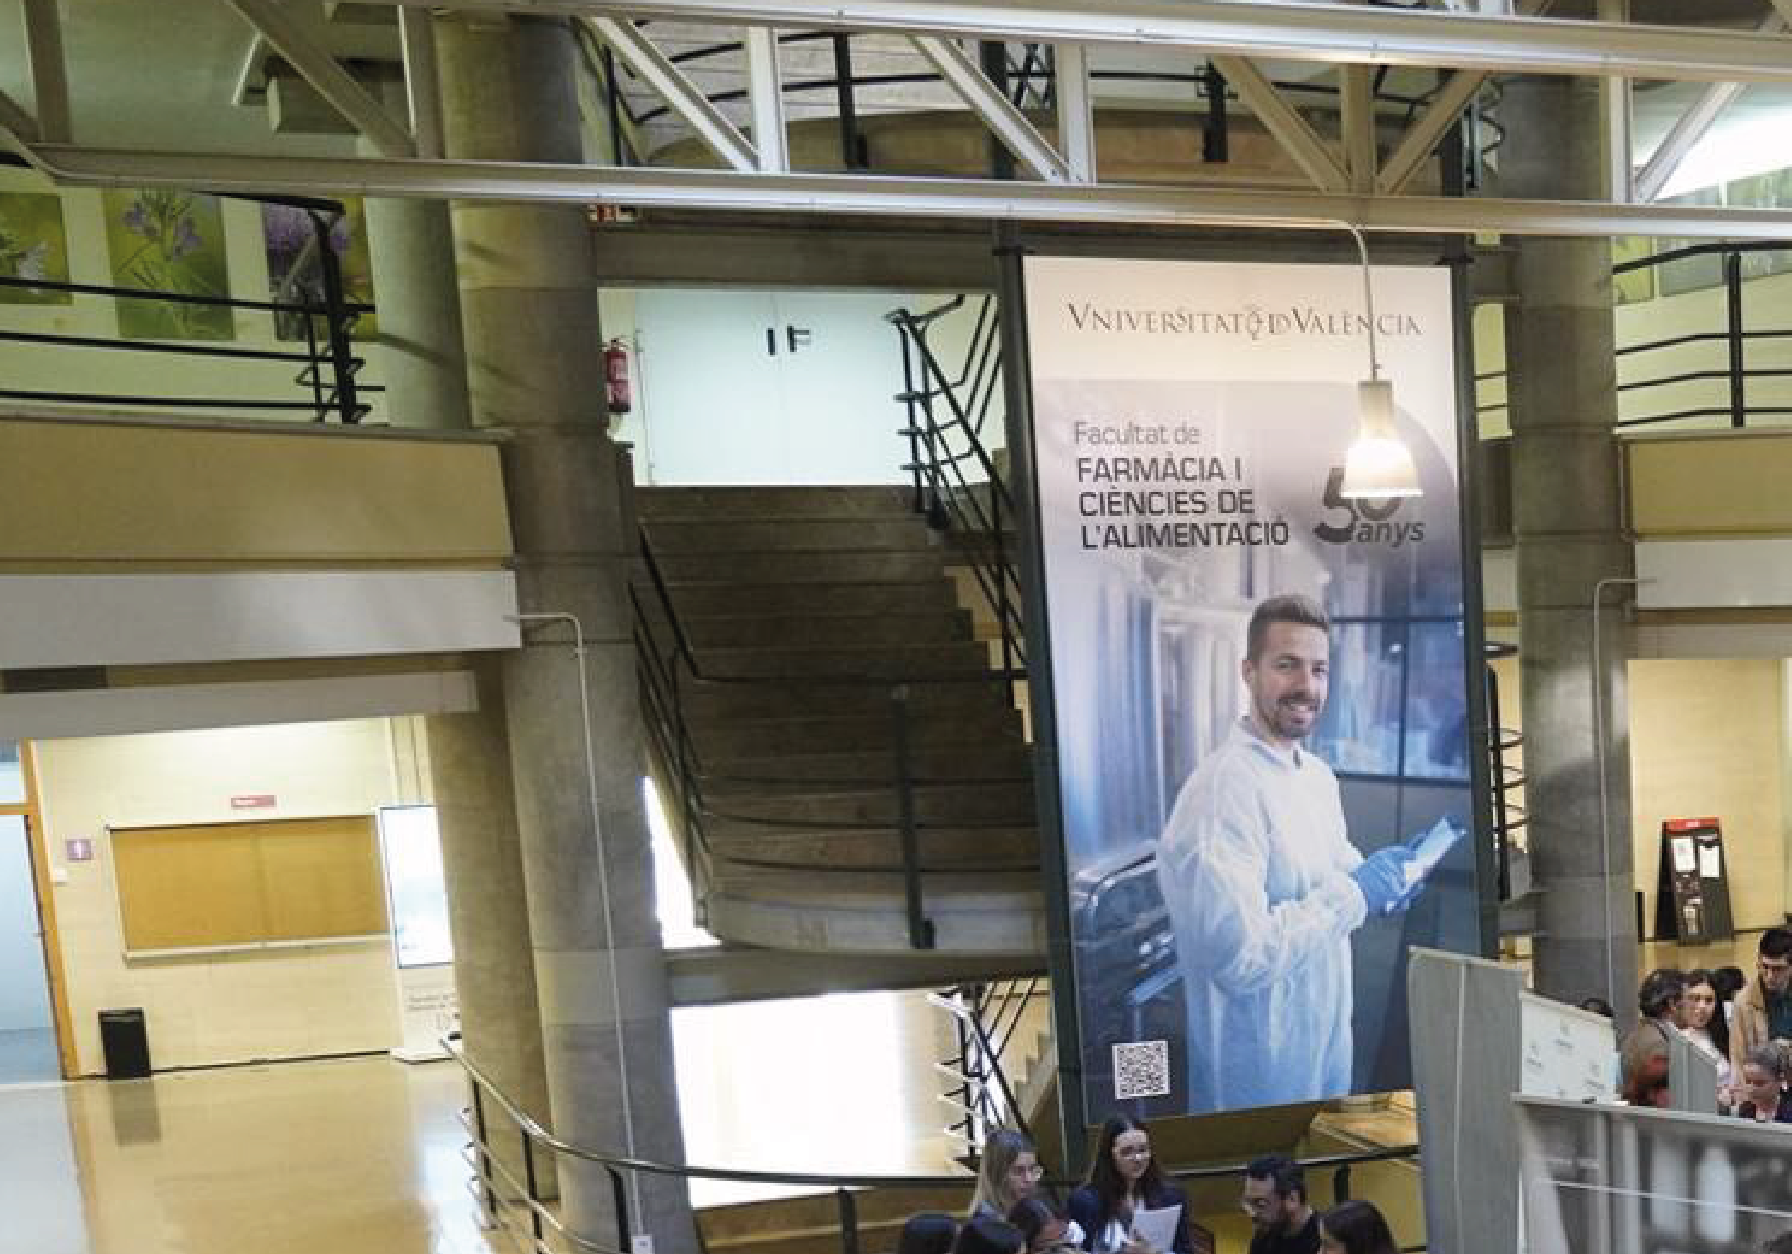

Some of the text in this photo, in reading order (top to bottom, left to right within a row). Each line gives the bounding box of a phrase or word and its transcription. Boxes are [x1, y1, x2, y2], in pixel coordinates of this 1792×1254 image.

[1074, 420, 1200, 445] Facultat de
[1078, 451, 1242, 482] FARMÀCIA I
[1079, 486, 1256, 516] CIÈNCIES DE
[1081, 514, 1290, 549] L'ALIMENTACIÓ
[1357, 521, 1426, 547] anys
